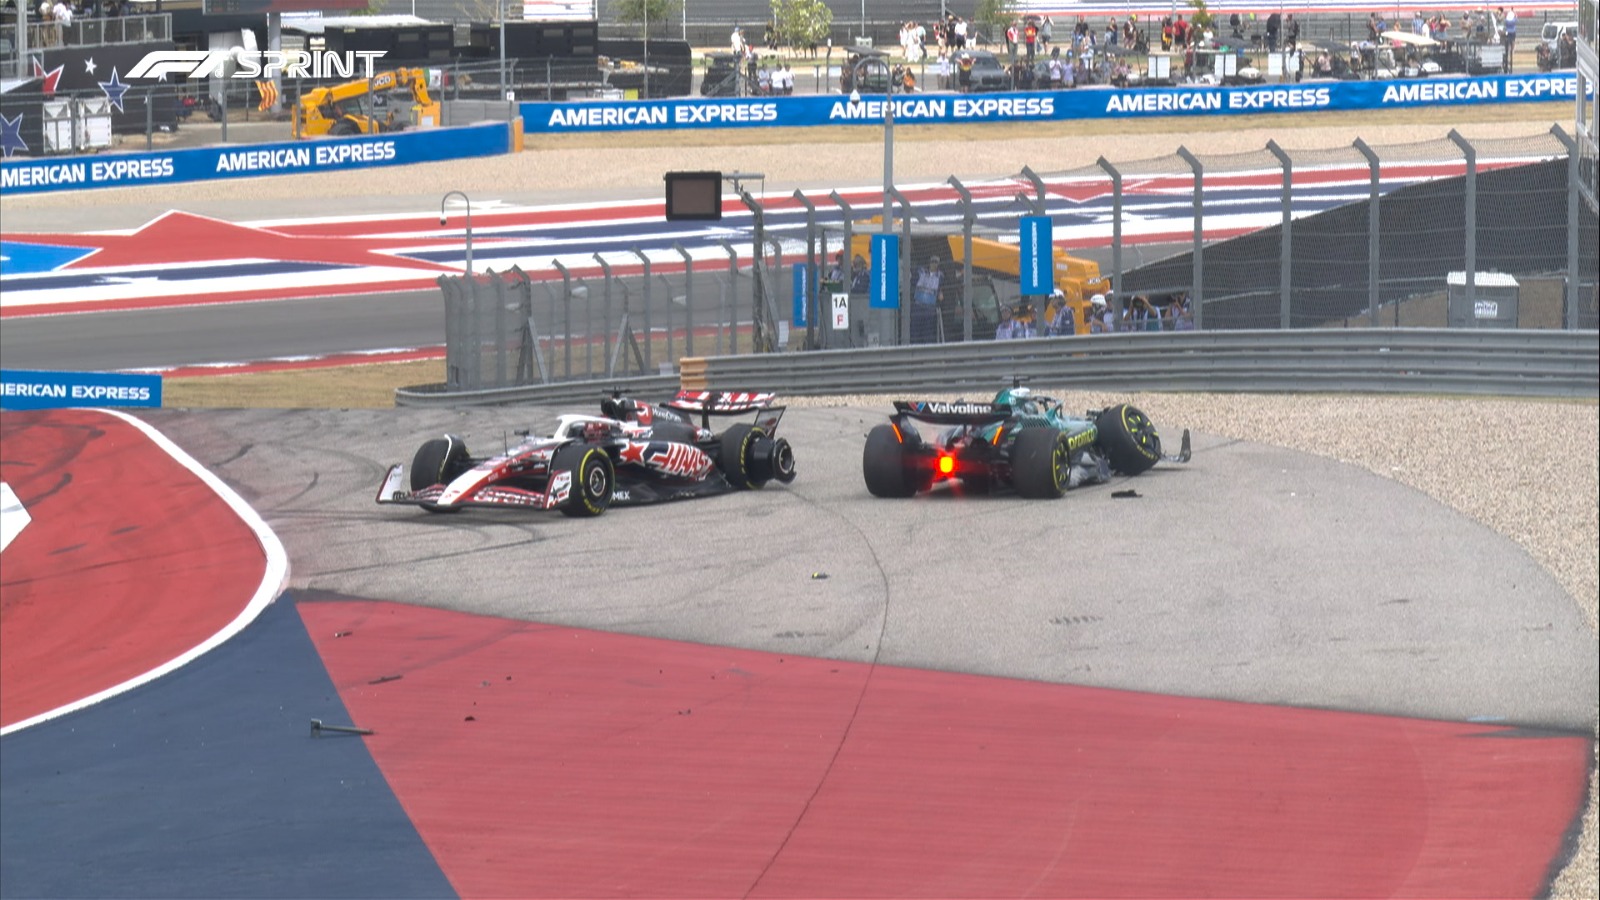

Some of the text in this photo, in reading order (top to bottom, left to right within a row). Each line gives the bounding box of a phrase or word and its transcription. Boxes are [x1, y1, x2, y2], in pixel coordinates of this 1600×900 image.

[1105, 87, 1330, 113] AMERICAN EXPRESS
[1382, 80, 1498, 103] AMERICAN
[548, 103, 778, 126] AMERICAN EXPRESS
[829, 97, 1055, 119] AMERICAN EXPRESS
[216, 140, 396, 173] AMERICAN EXPRESS
[1, 157, 174, 188] MERICAN EXPRESS
[834, 297, 847, 309] 1A
[837, 315, 844, 326] F
[0, 383, 151, 400] ERICAN EXPRESS
[927, 401, 993, 415] Valvoline
